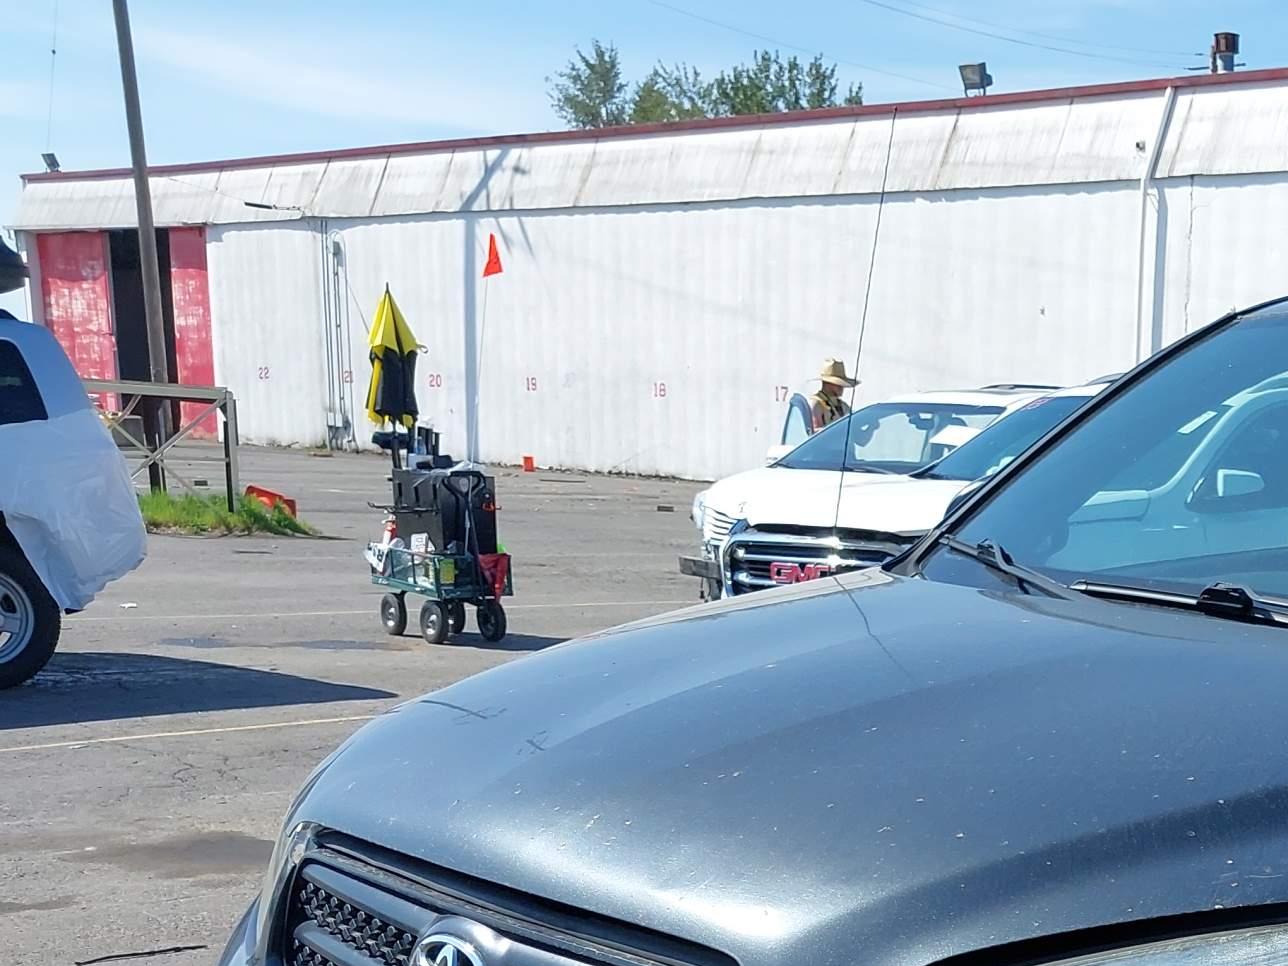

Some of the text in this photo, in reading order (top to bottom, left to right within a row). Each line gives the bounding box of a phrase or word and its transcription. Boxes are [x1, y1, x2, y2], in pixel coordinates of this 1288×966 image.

[258, 367, 270, 380] 22
[428, 374, 442, 387] 20
[526, 377, 537, 391] 19
[653, 383, 666, 397] 18
[774, 386, 789, 402] 17
